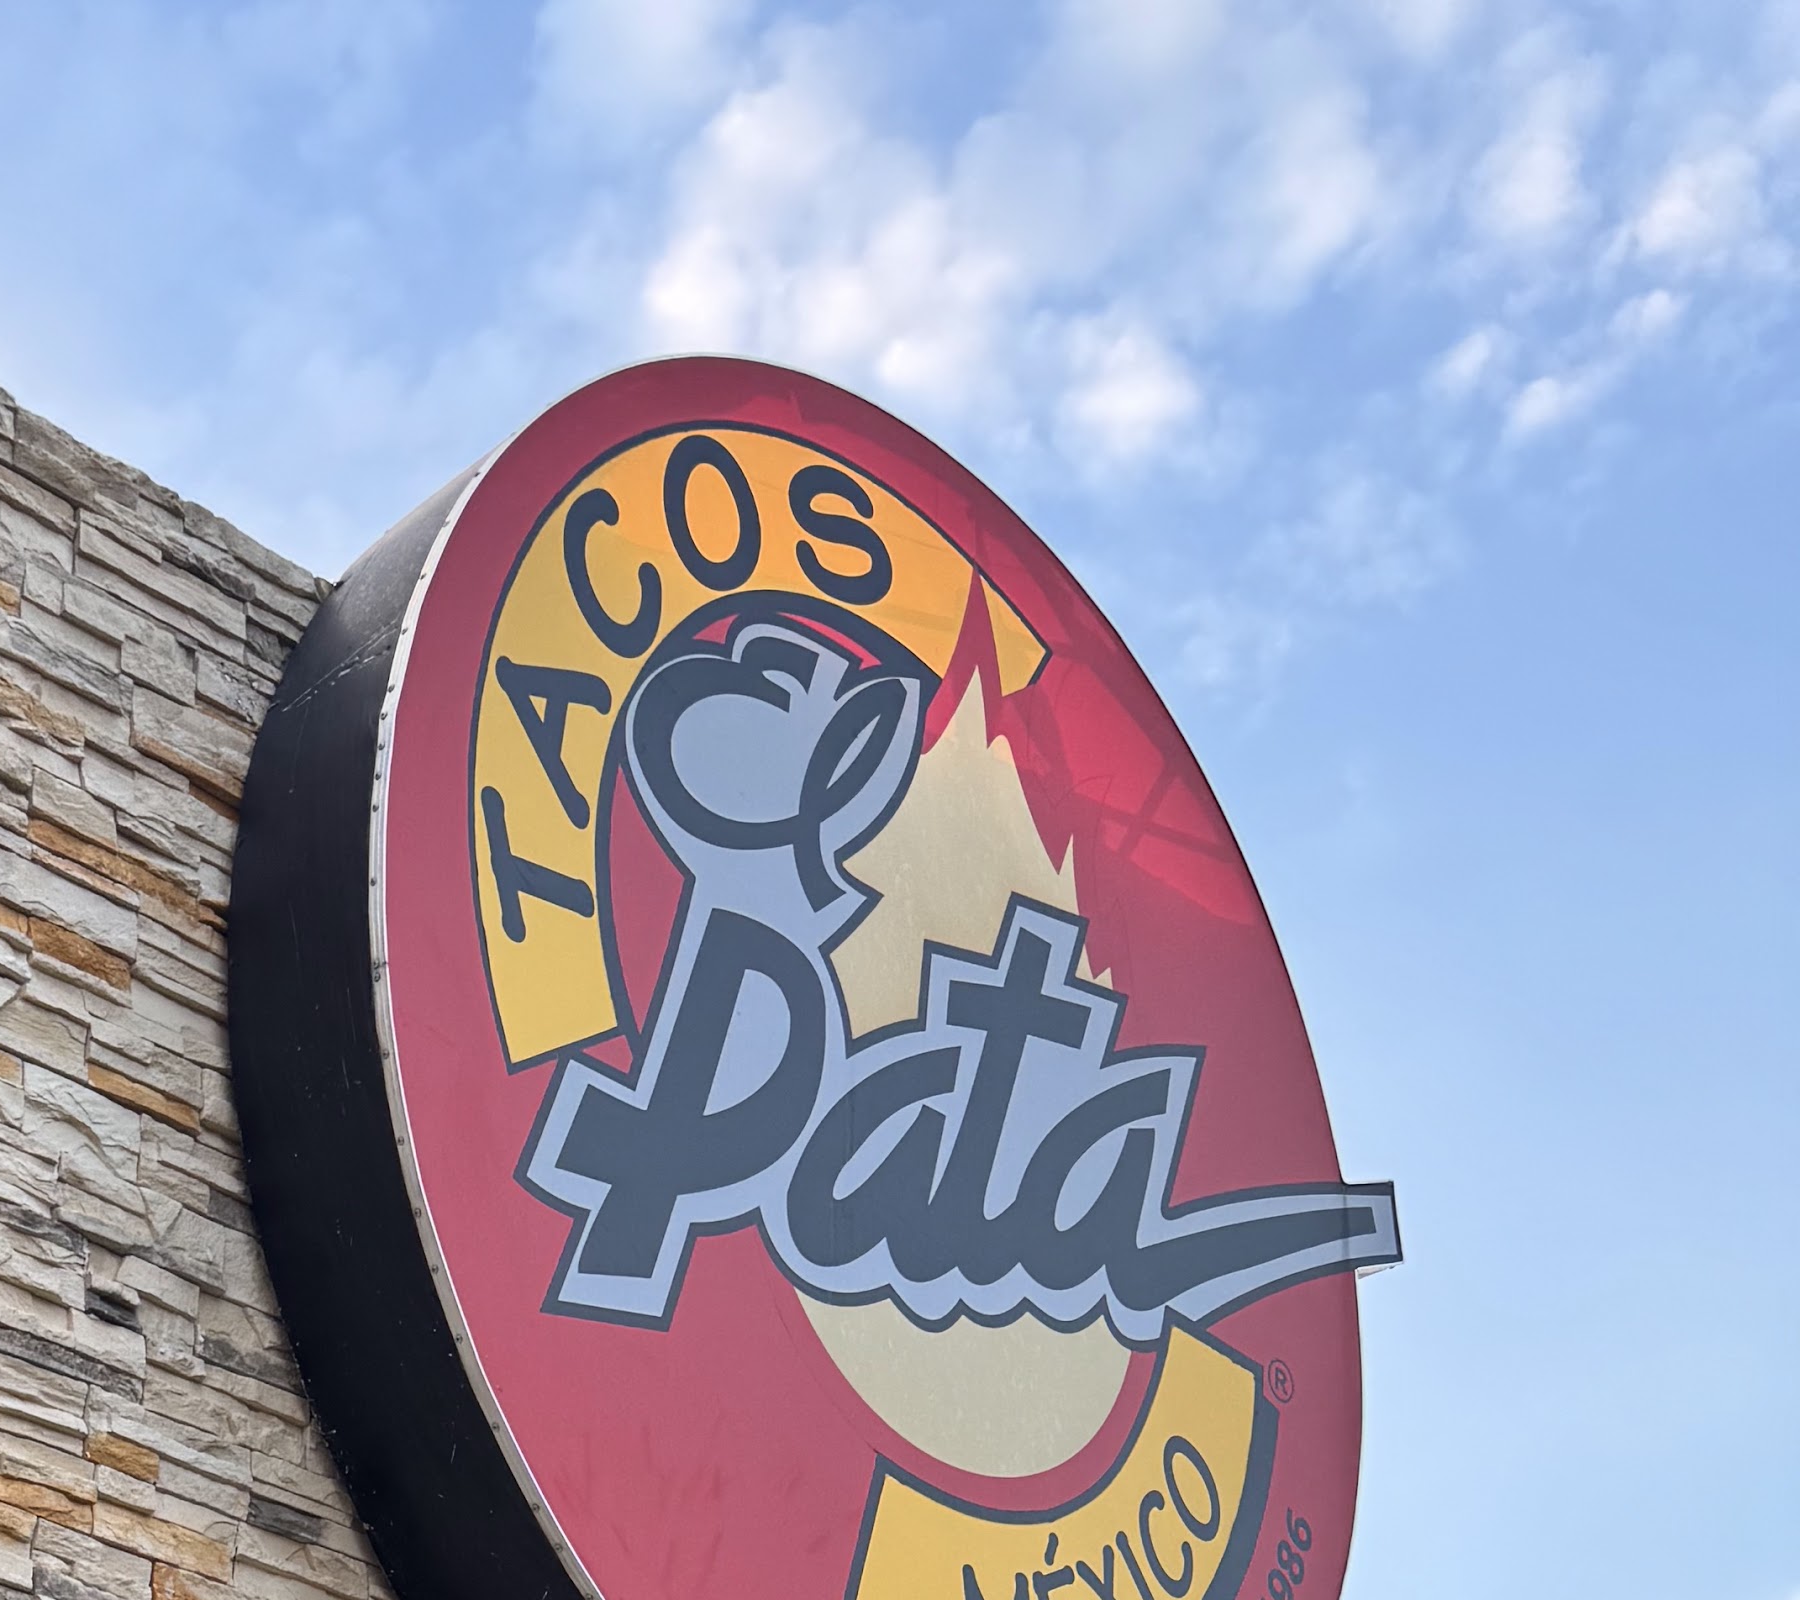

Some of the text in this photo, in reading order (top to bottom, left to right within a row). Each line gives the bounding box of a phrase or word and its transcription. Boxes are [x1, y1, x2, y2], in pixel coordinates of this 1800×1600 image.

[503, 433, 895, 946] TACOS
[632, 635, 908, 913] El
[556, 906, 1386, 1292] Pata
